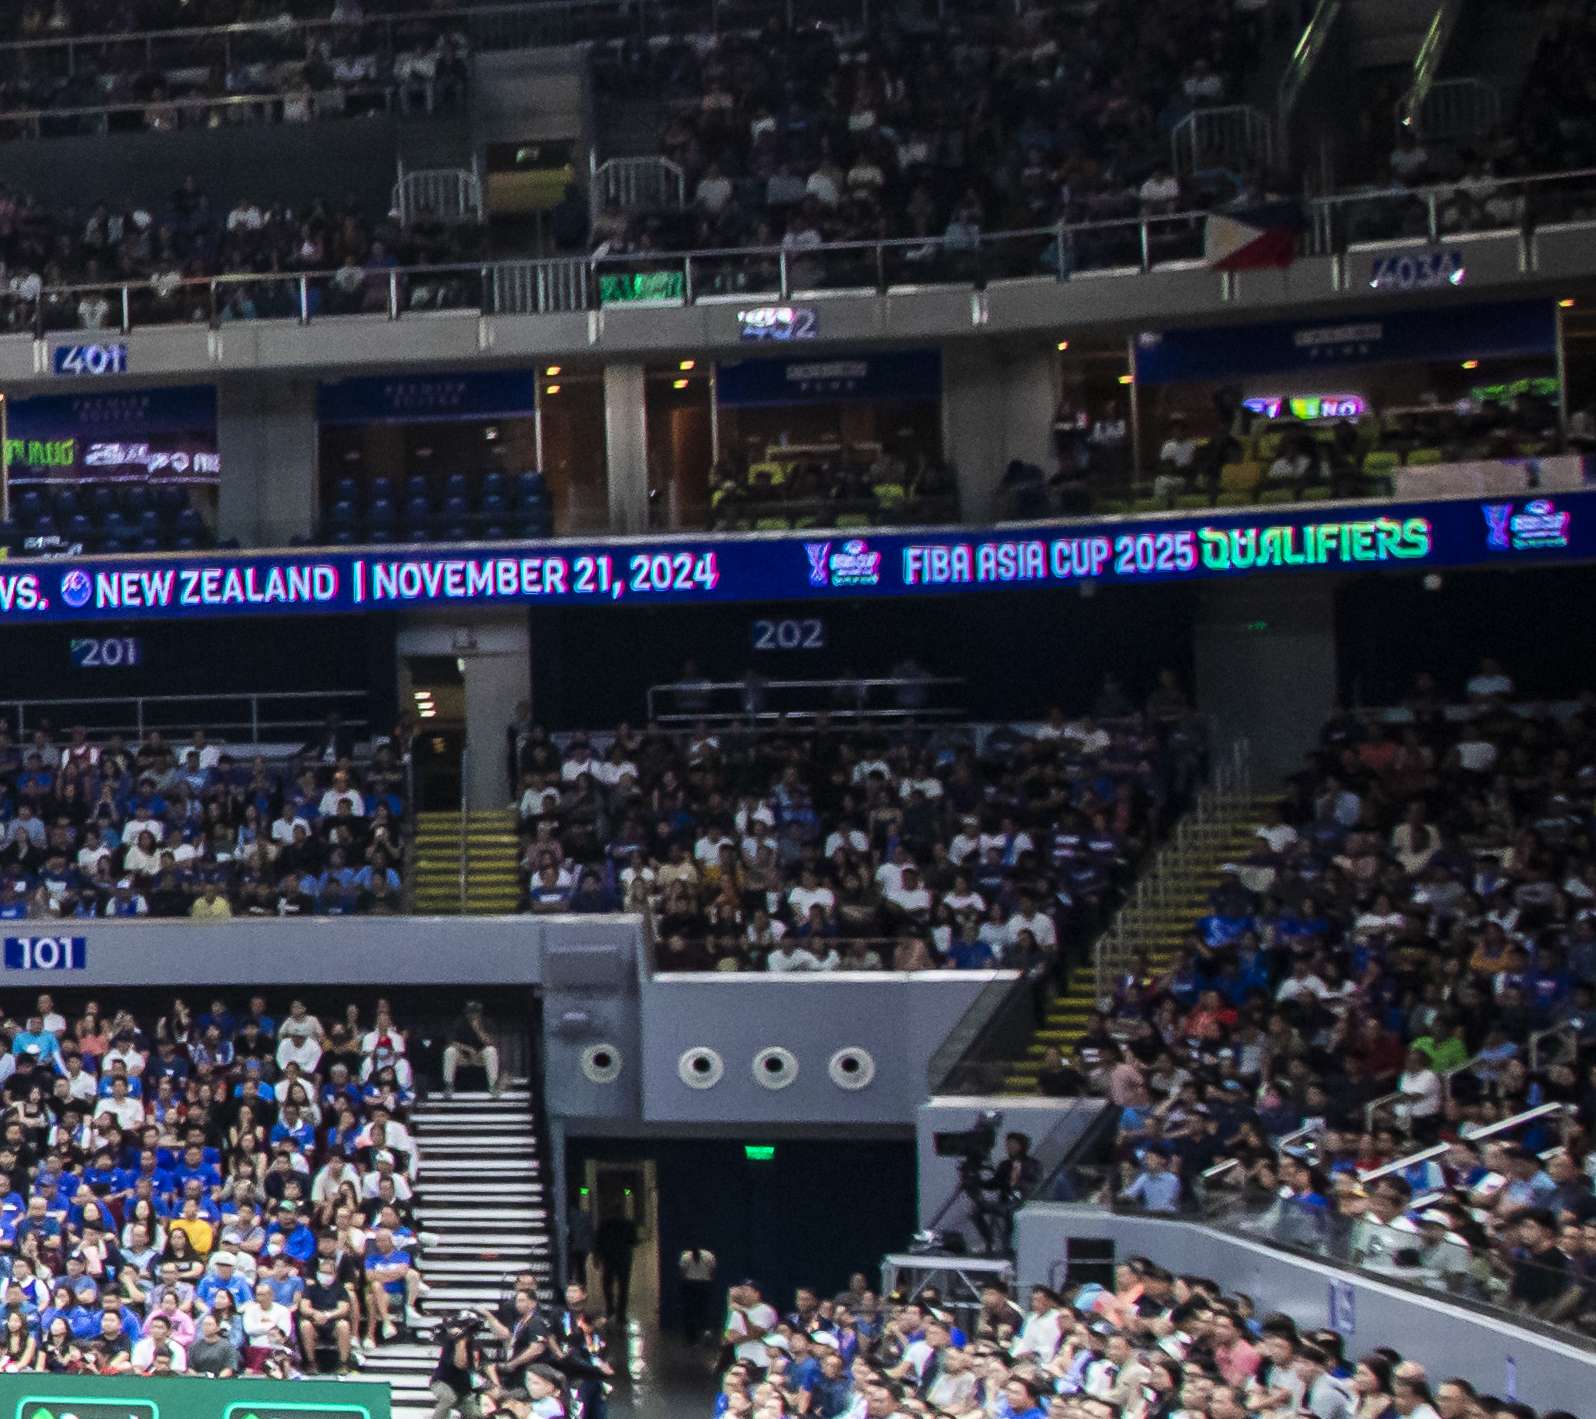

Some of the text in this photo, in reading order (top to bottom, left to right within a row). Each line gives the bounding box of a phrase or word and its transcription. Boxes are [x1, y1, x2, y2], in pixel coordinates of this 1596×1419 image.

[57, 346, 127, 374] 401
[902, 516, 1432, 585] FIBA ASIA CUP 2025 QUALIFIERS
[94, 571, 173, 608] NEW
[178, 565, 337, 606] ZEALAND
[374, 558, 569, 600] NOVEMBER
[574, 555, 624, 597] 21,
[630, 550, 720, 593] 2024
[754, 618, 825, 650] 202
[77, 638, 137, 668] 201
[18, 938, 76, 970] 101
